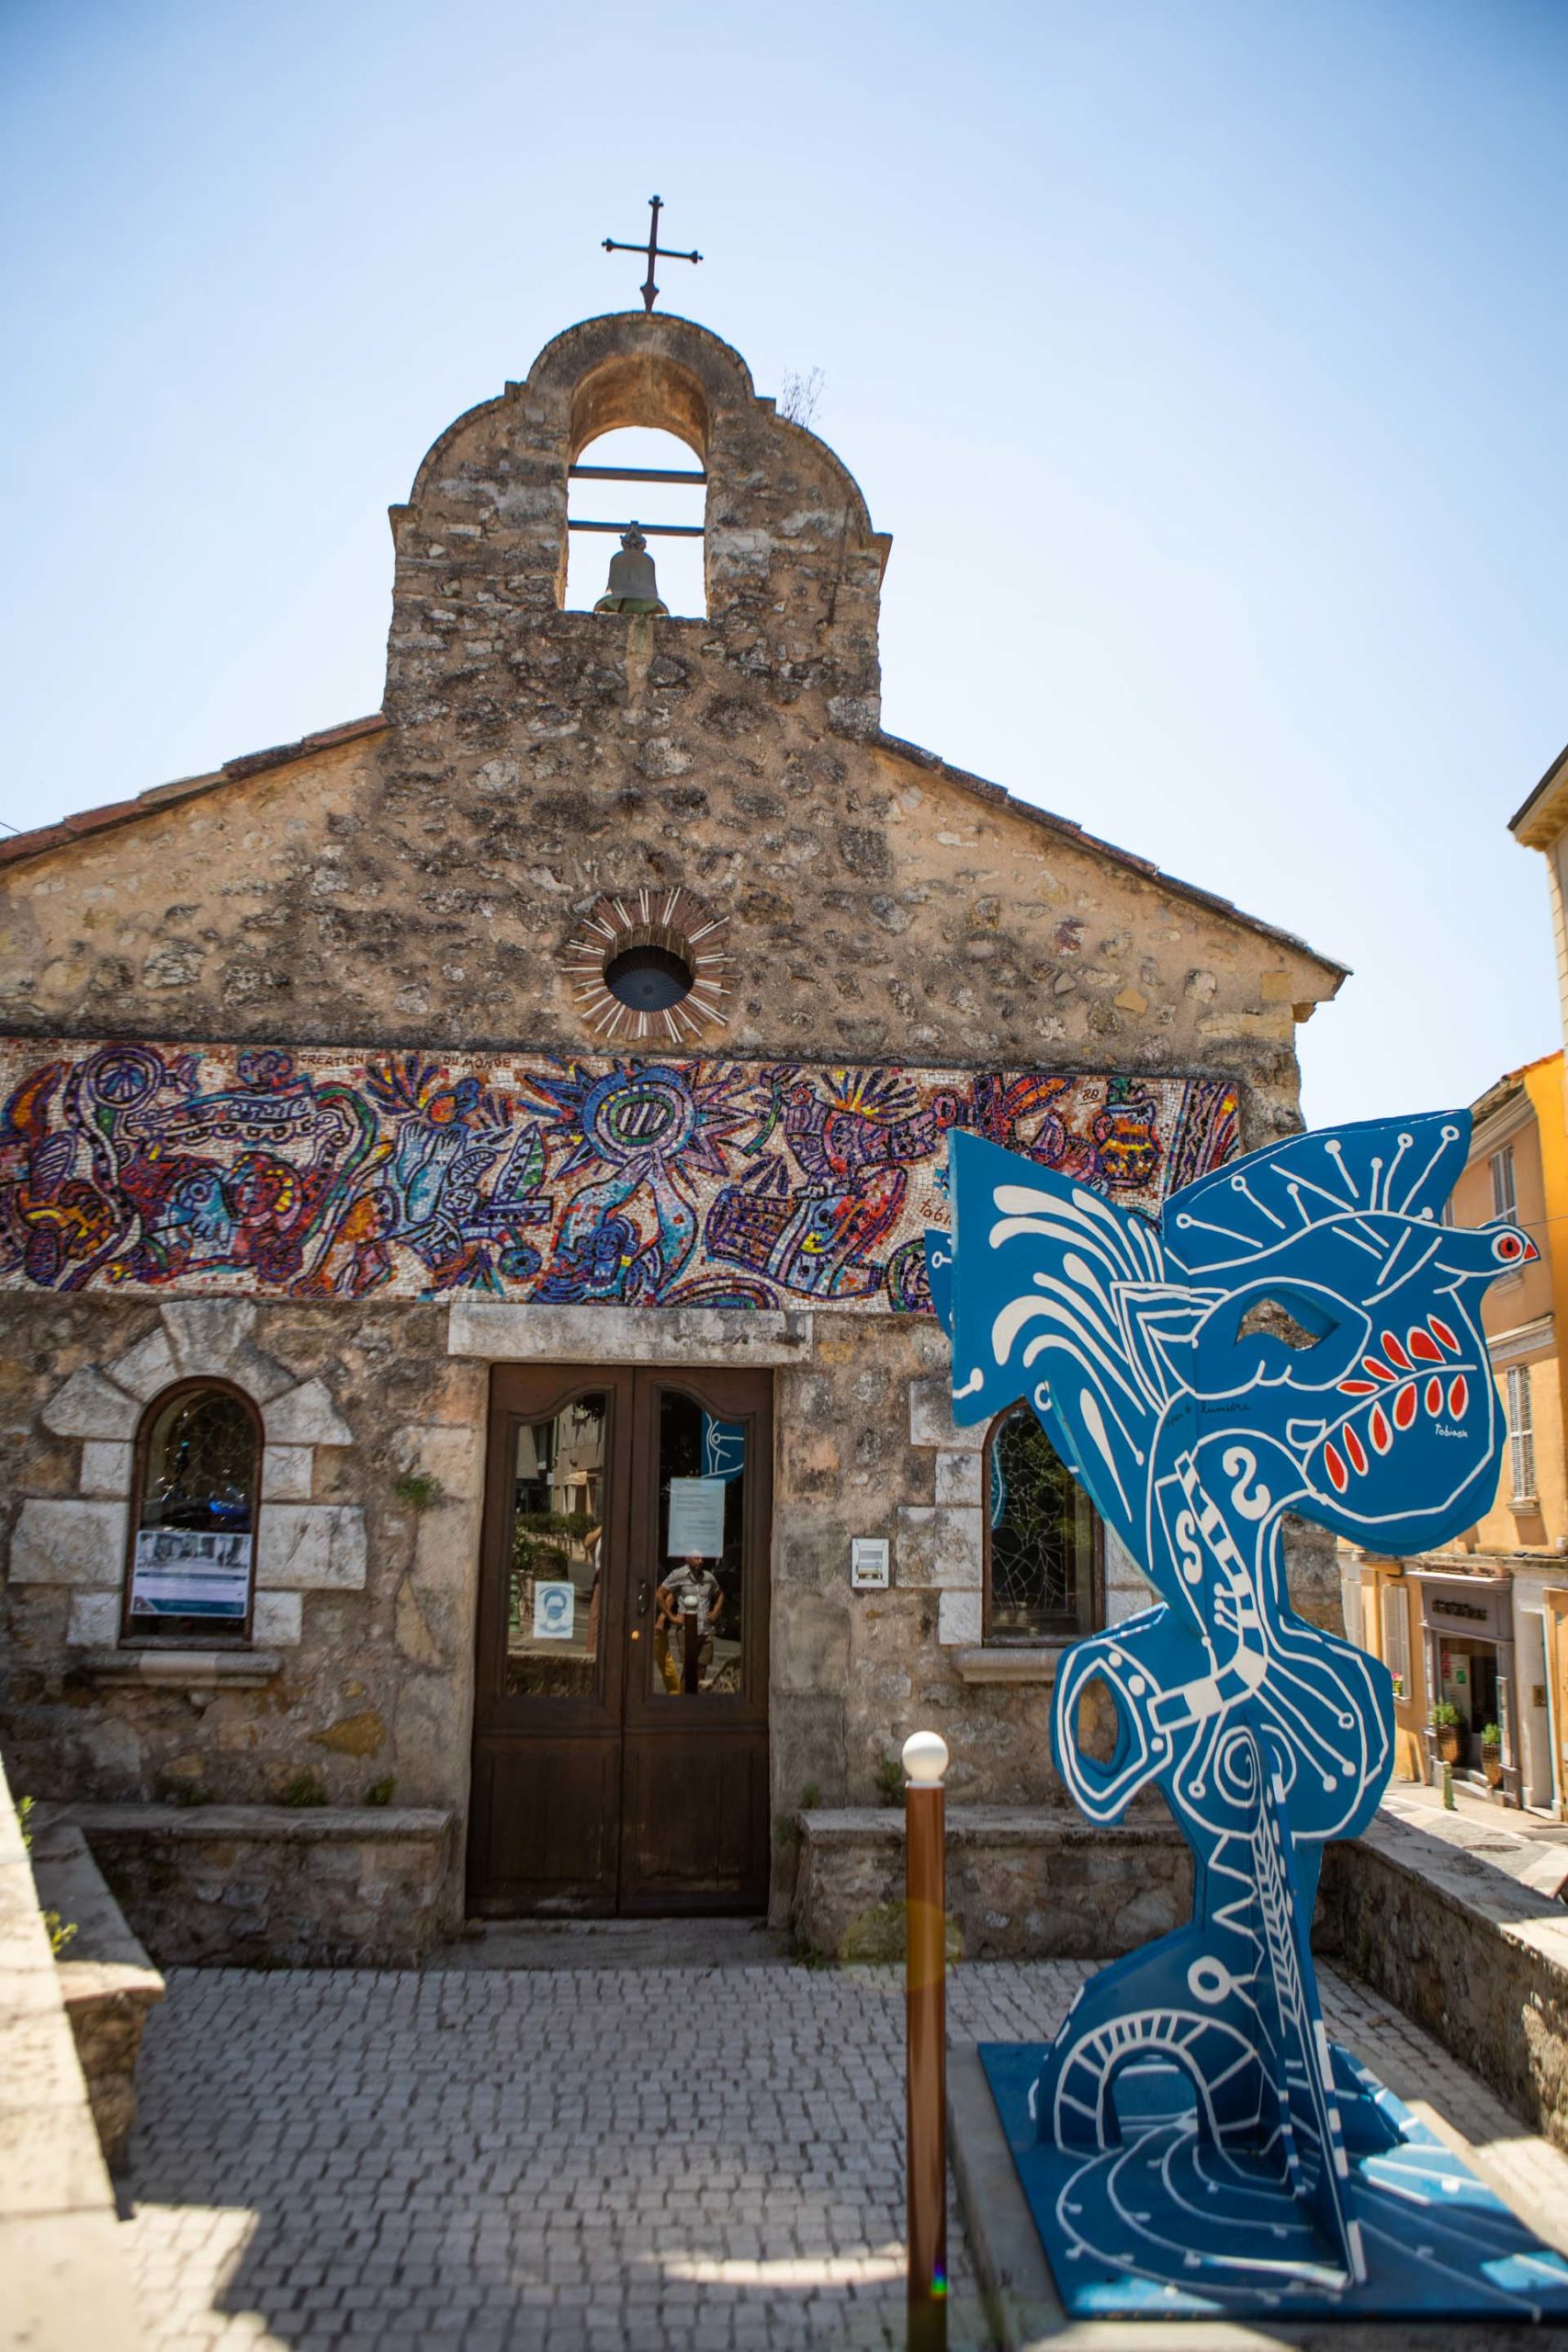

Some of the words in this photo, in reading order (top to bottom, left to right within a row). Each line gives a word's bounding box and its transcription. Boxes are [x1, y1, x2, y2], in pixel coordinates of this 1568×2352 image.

[299, 1054, 366, 1067] CREATION
[444, 1055, 458, 1066] DU
[461, 1057, 512, 1070] MONDE
